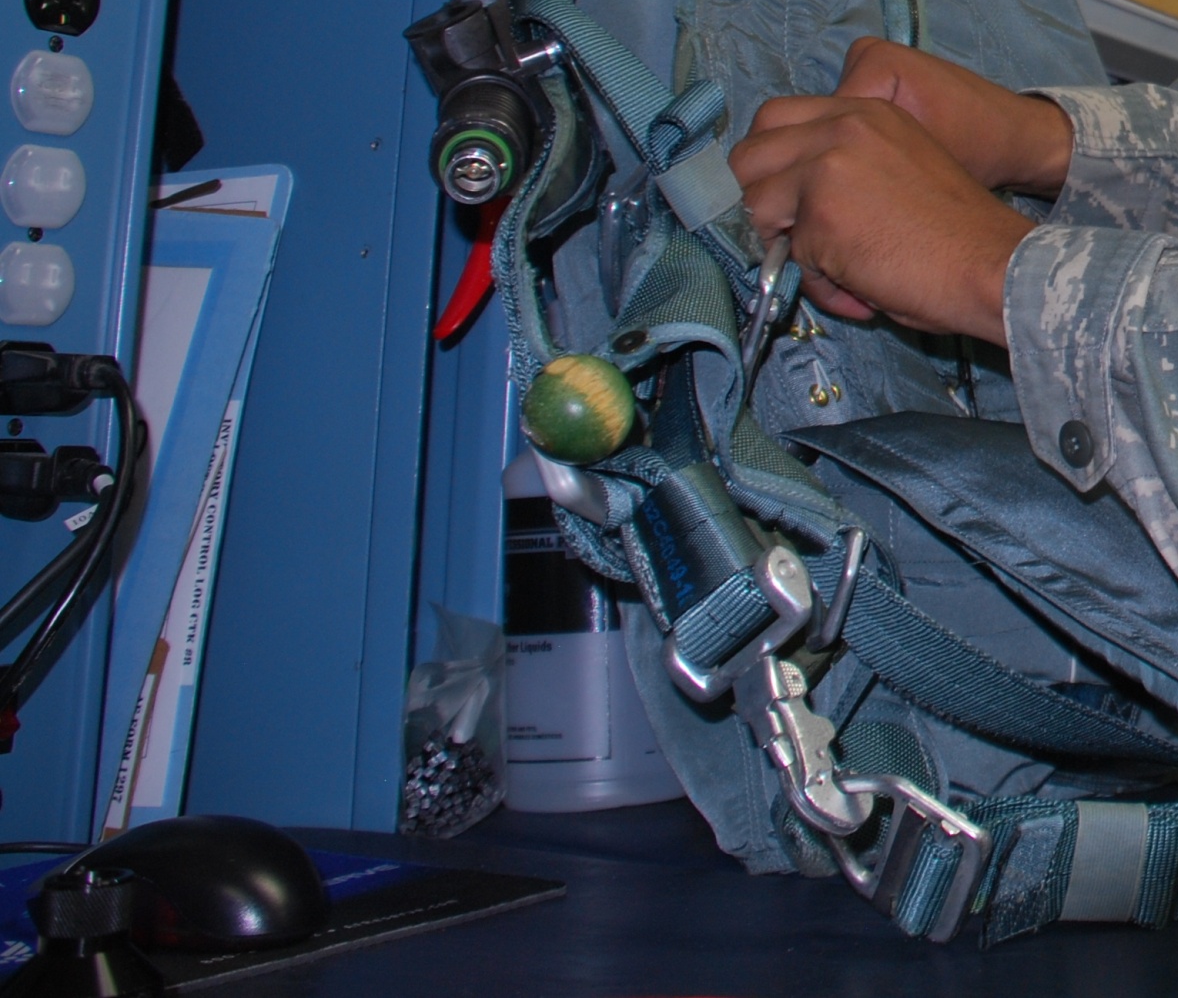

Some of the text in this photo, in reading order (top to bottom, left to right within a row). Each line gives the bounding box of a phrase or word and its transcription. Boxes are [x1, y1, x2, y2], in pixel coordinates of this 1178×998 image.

[196, 504, 216, 575] CONTROL
[191, 578, 205, 609] LOG
[186, 613, 199, 643] CTK
[520, 640, 553, 655] Liquids
[122, 718, 139, 761] FORM
